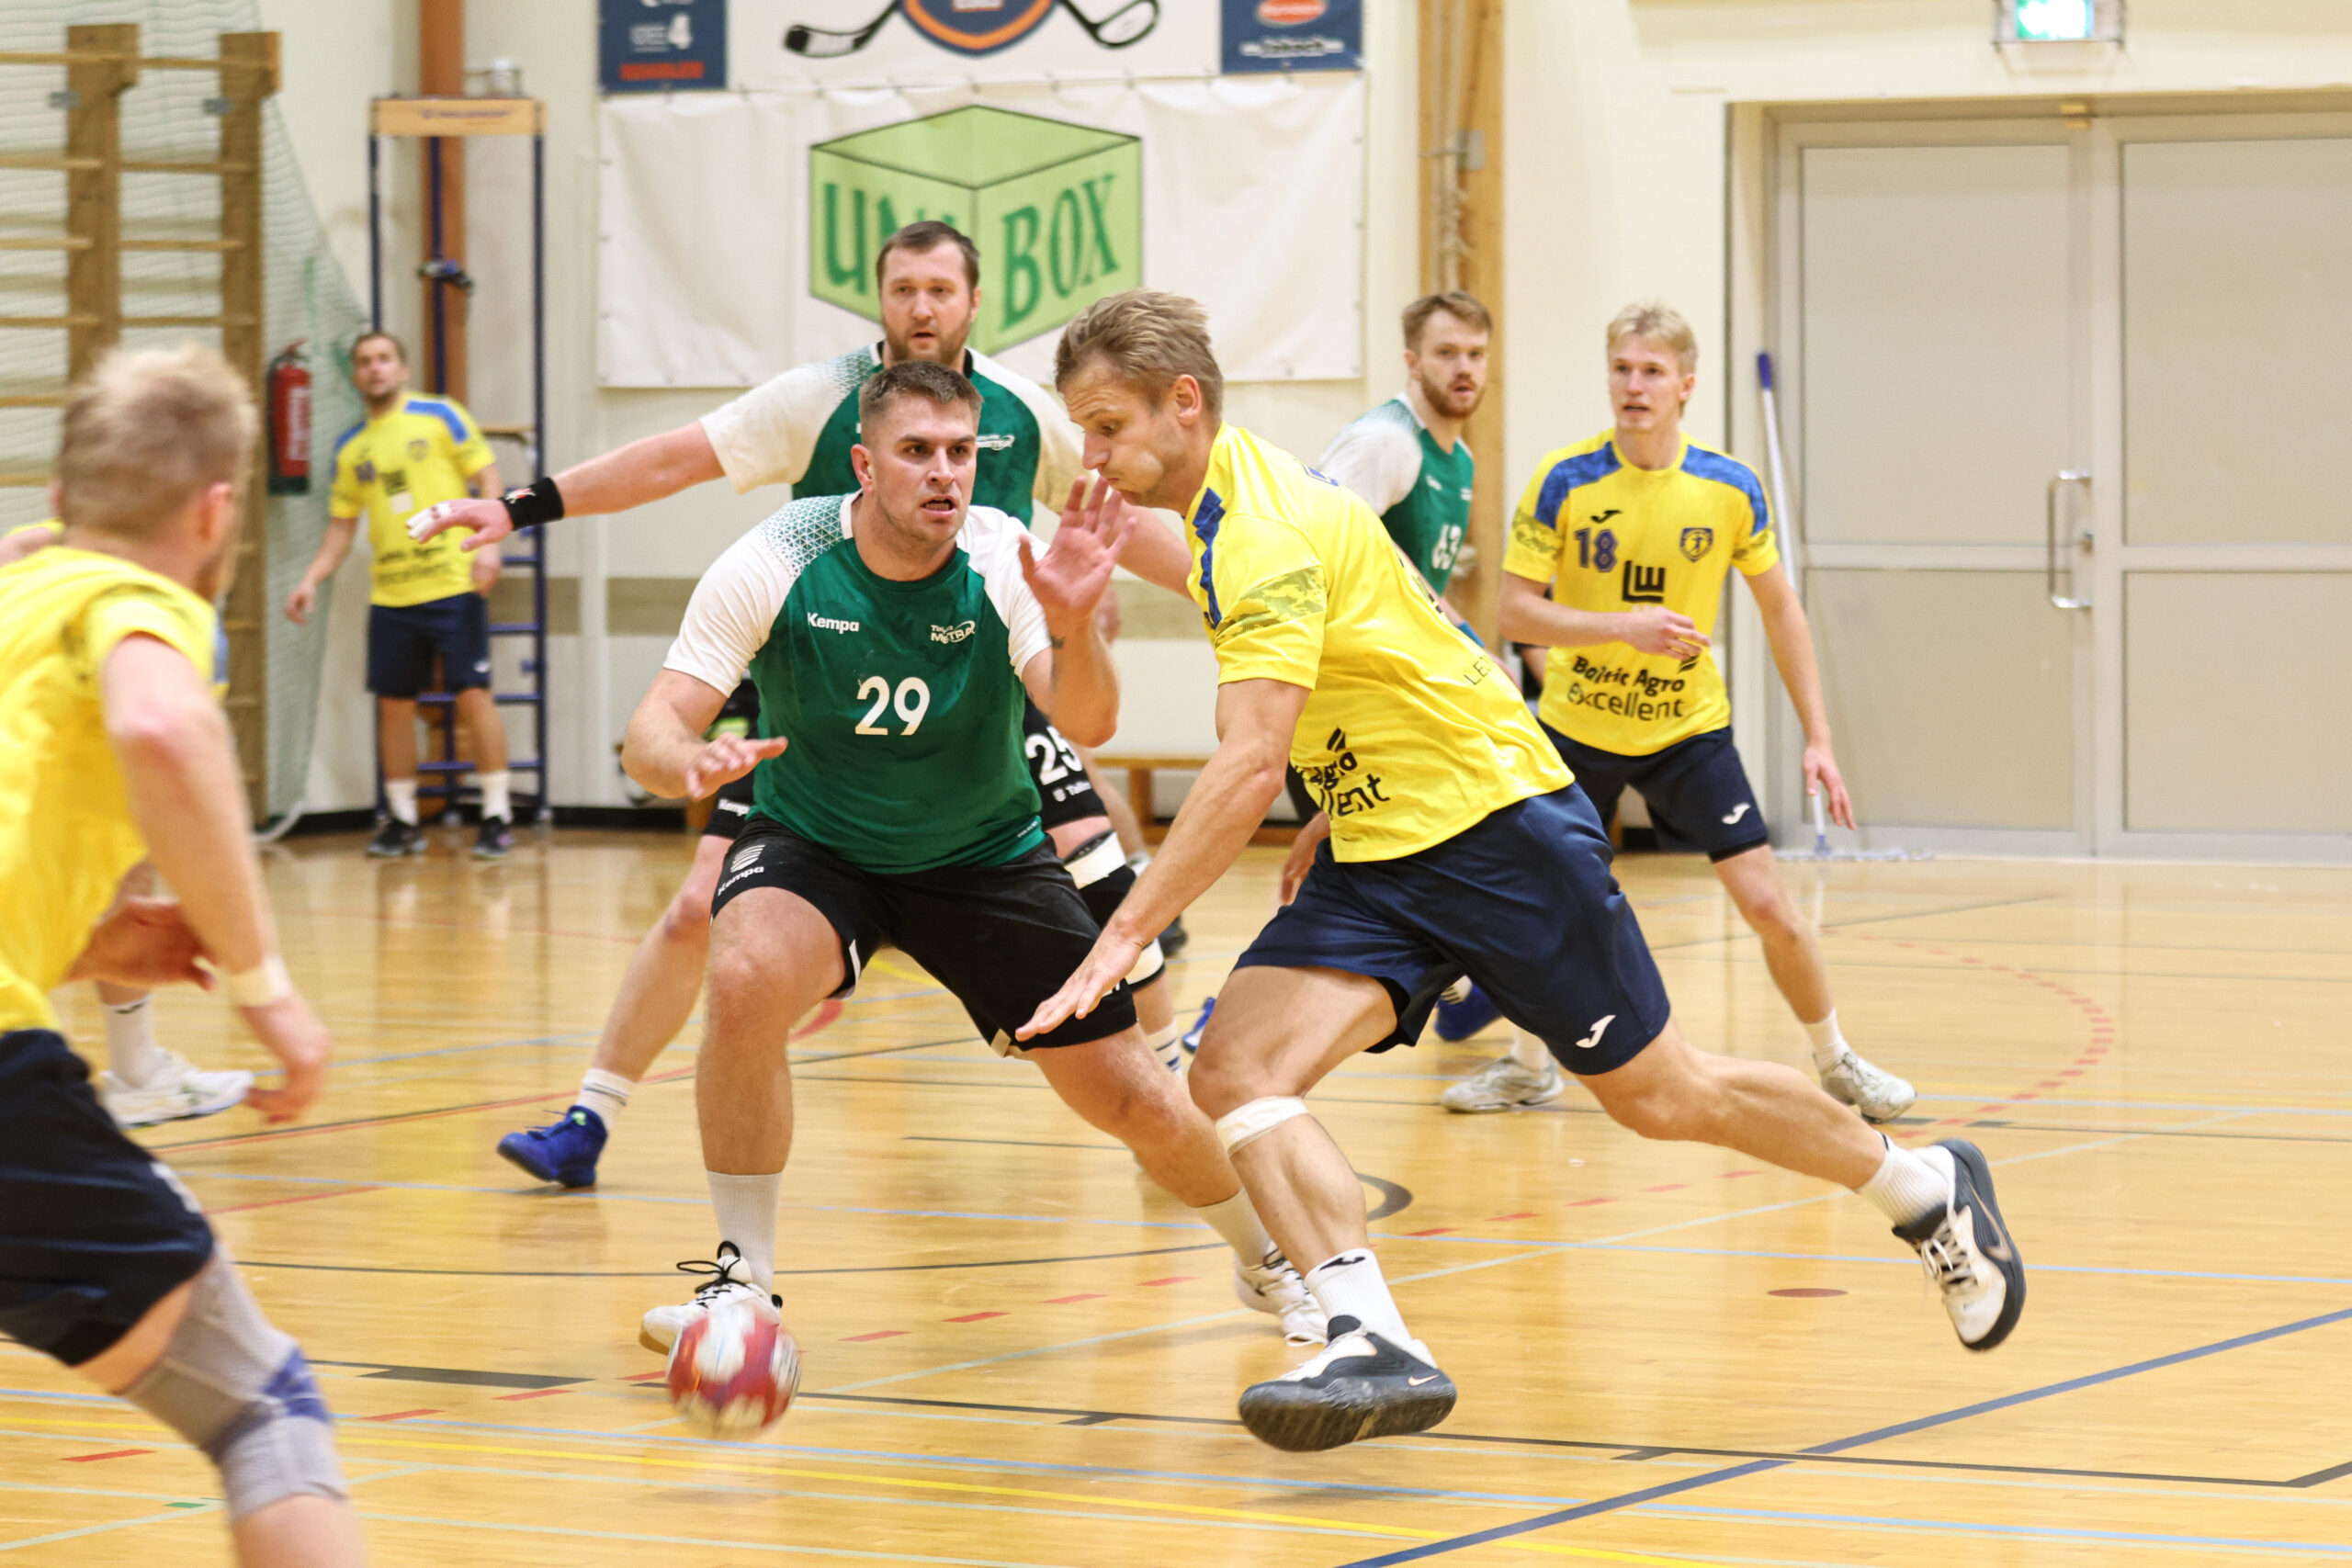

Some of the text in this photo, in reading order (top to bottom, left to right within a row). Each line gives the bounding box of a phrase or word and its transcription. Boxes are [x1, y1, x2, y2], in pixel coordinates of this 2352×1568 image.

[1001, 173, 1119, 332] BOX
[1574, 527, 1618, 573] 18
[807, 612, 860, 635] Kempa
[854, 675, 931, 736] 29
[1633, 669, 1685, 697] Agro
[1024, 725, 1083, 785] 25
[717, 865, 764, 897] Kempa
